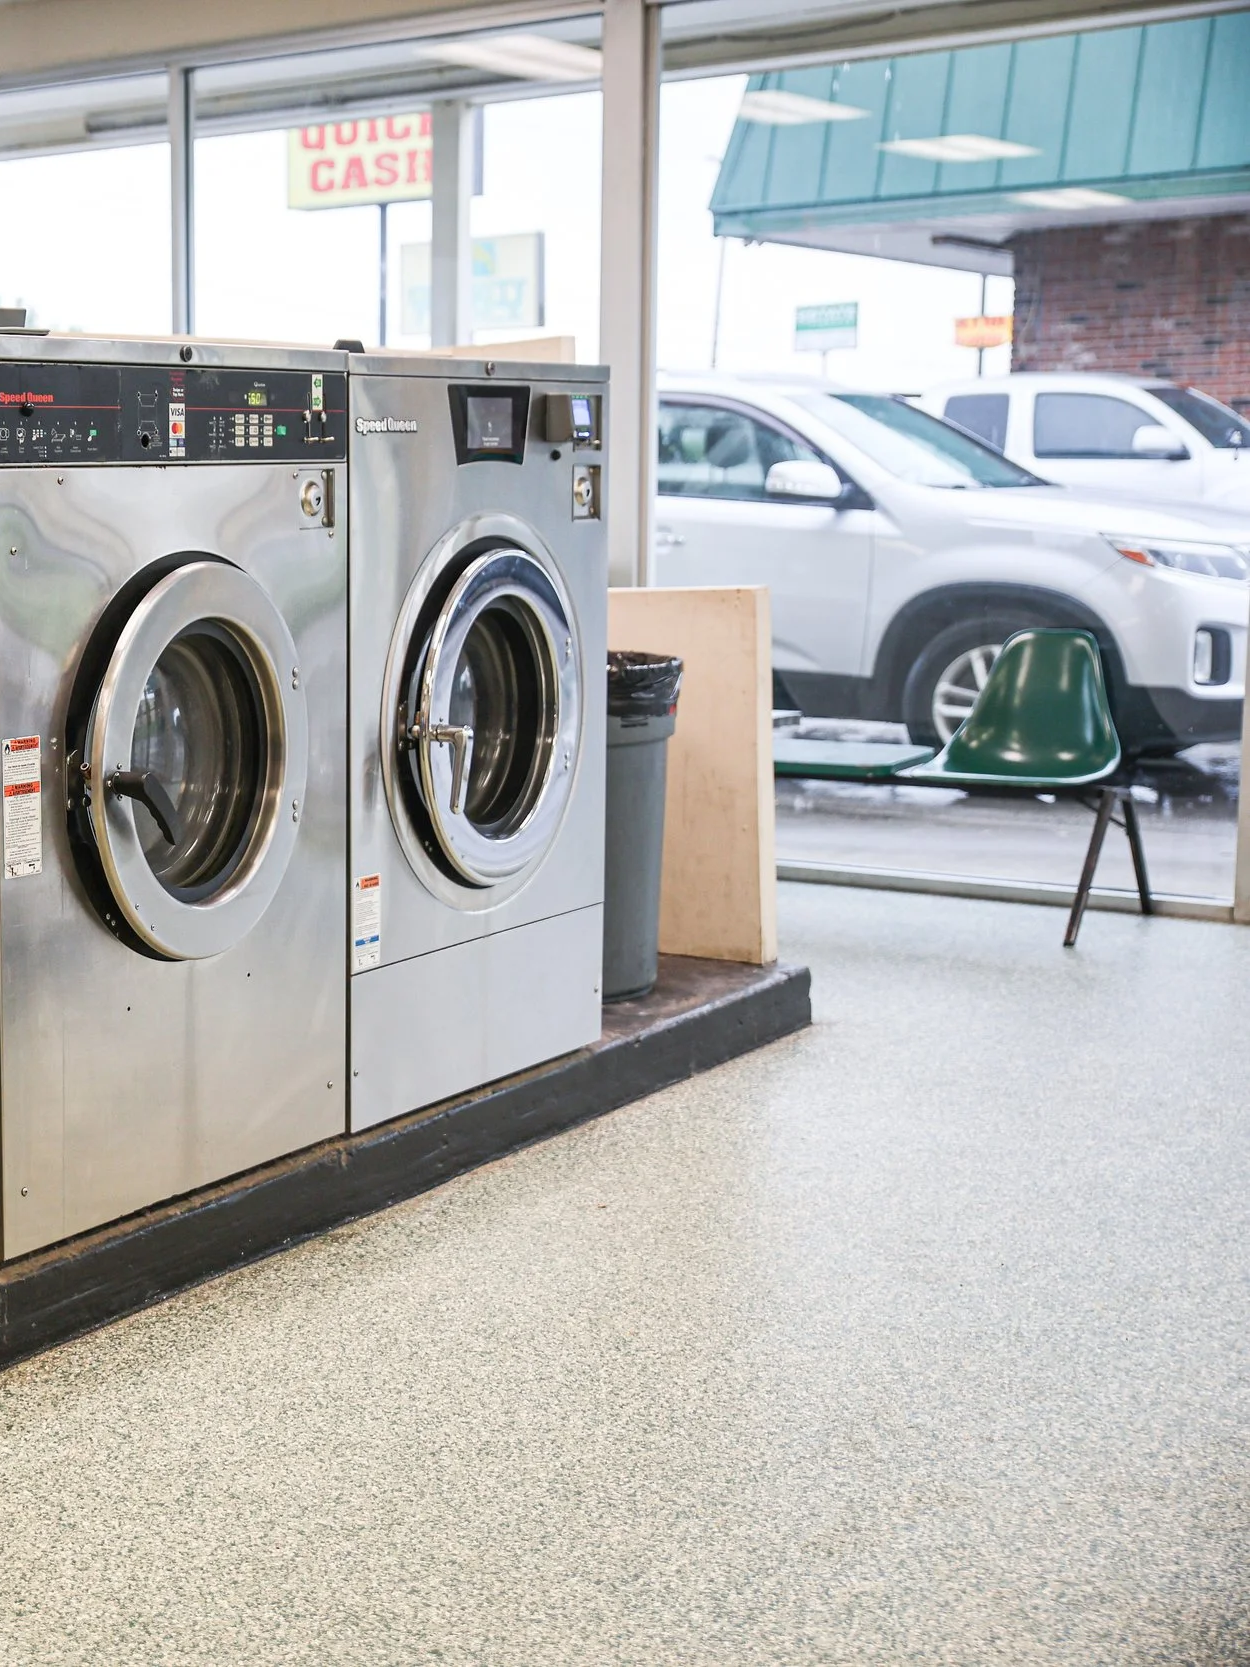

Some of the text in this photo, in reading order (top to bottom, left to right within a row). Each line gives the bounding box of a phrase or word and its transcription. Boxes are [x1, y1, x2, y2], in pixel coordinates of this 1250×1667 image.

[0, 391, 54, 404] Speed Queen
[170, 408, 185, 417] VISA
[356, 417, 417, 435] Speed Queen
